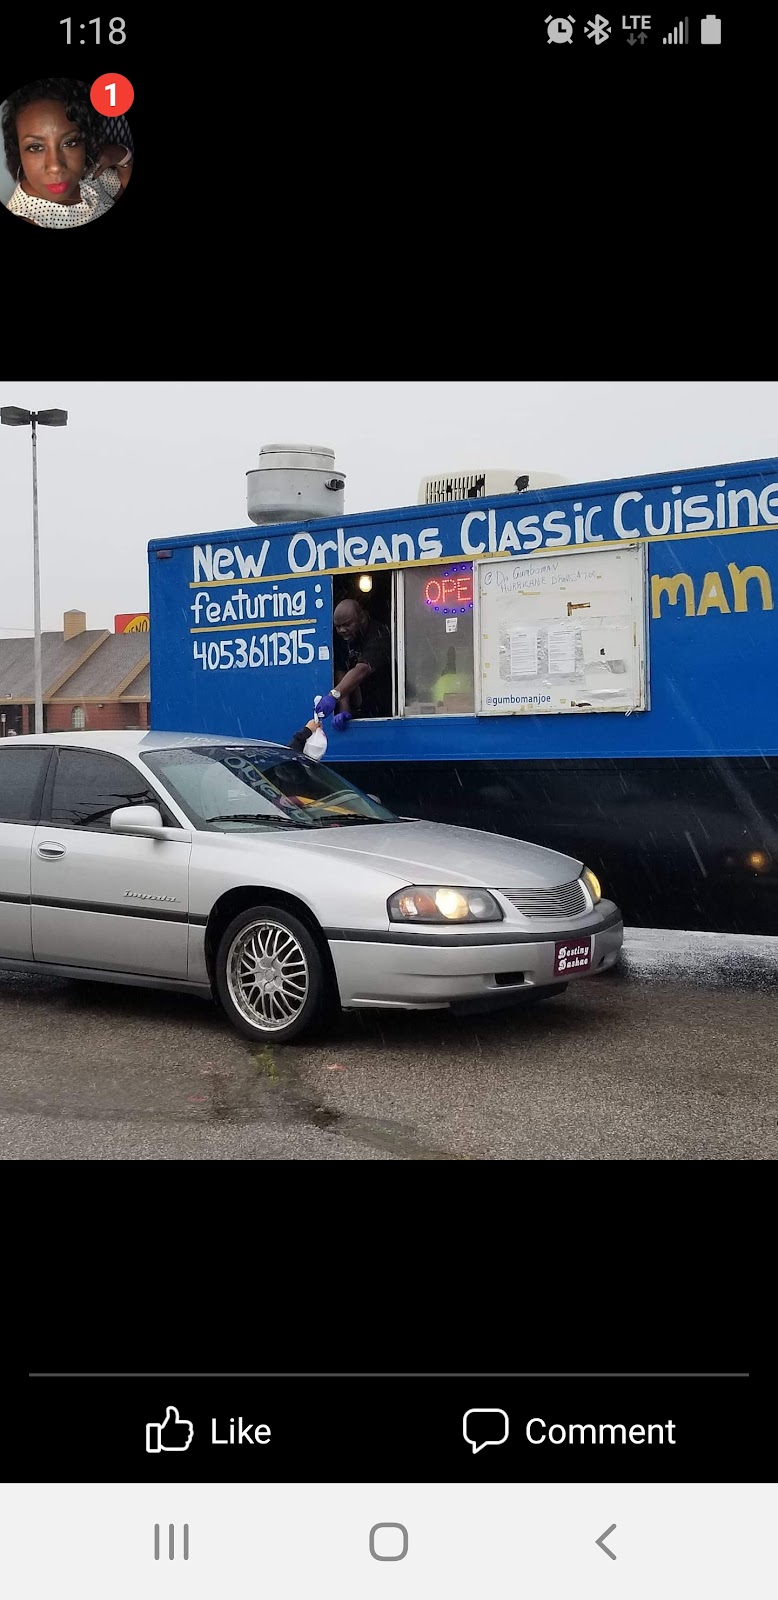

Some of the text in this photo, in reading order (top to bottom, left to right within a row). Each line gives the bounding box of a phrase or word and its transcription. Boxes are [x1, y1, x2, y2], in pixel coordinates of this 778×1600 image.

[425, 577, 472, 603] OPE
[486, 693, 551, 706] @gumbomanjoe
[558, 946, 589, 959] Destiny
